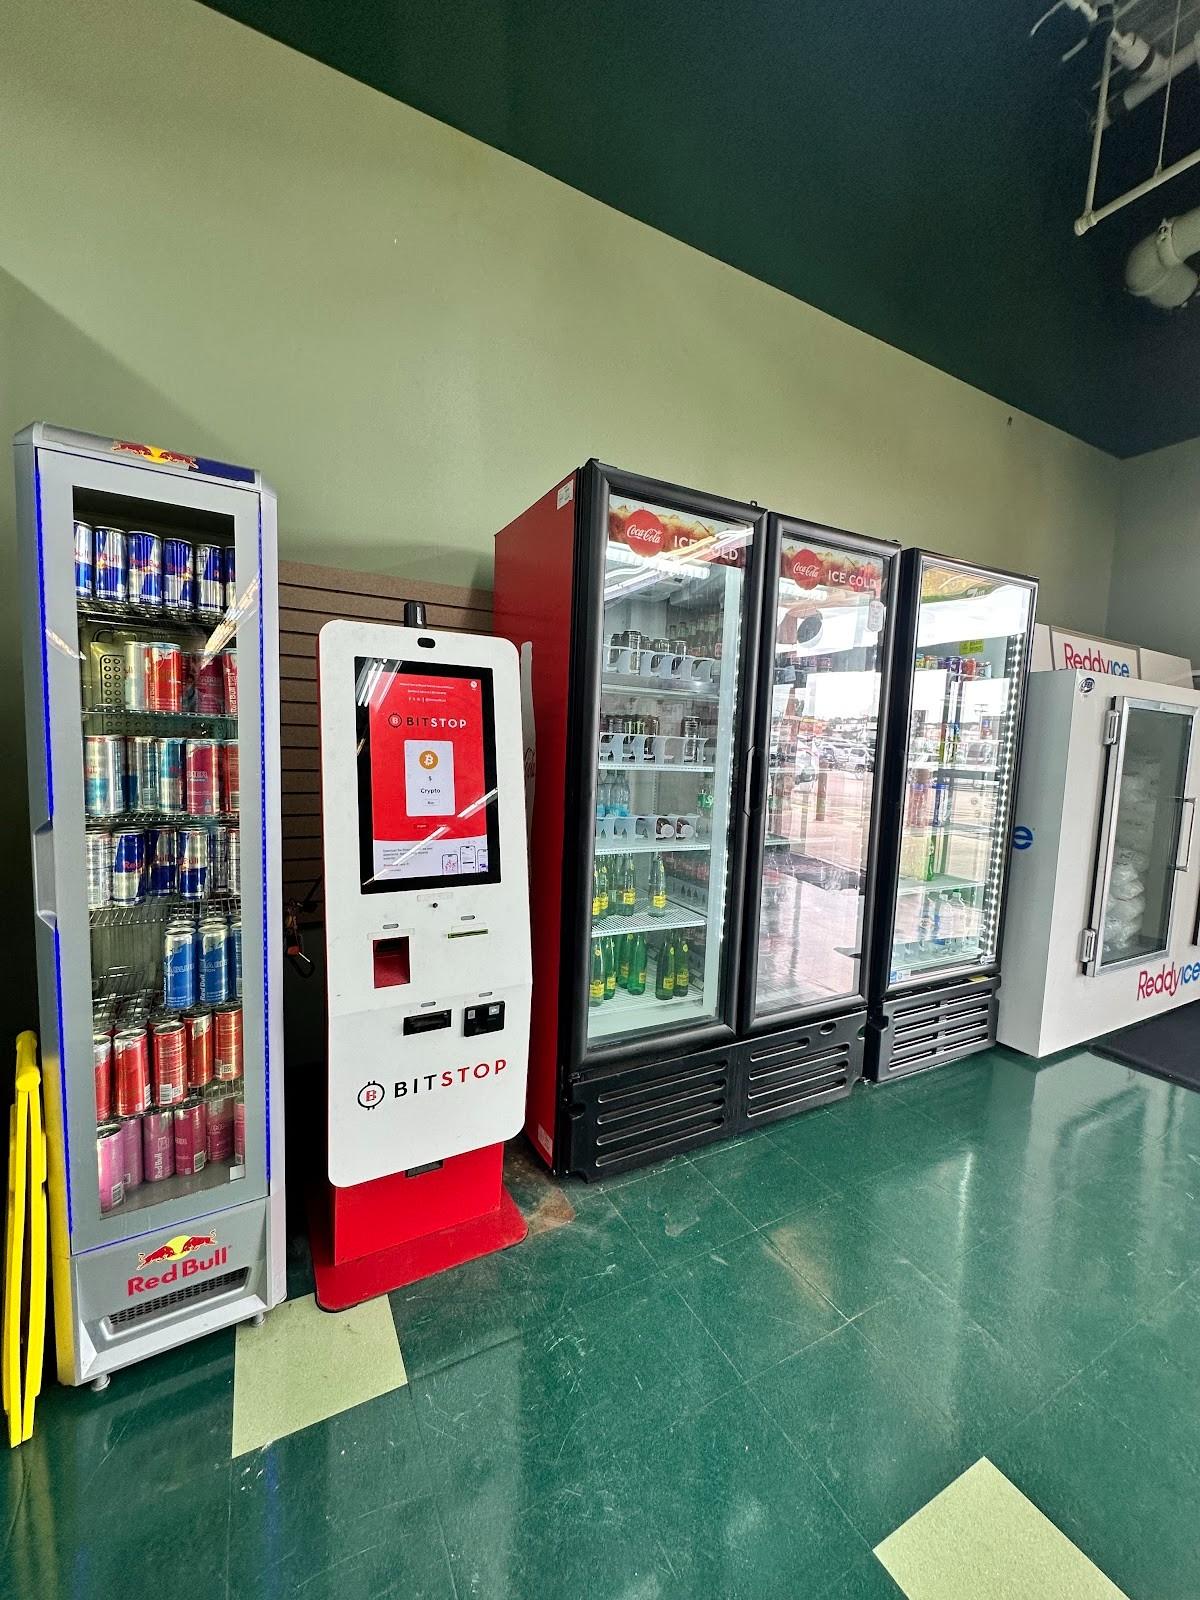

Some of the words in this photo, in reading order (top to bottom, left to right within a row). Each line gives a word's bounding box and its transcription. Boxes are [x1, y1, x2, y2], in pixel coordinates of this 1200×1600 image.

[626, 524, 662, 544] Coca-Cola
[828, 569, 846, 583] ICE
[849, 575, 876, 588] COLD
[406, 716, 467, 729] BITSTOP
[420, 787, 441, 795] Crypto
[394, 1058, 507, 1099] BITSTOP
[127, 1264, 178, 1297] Red
[182, 1247, 228, 1278] Bull
